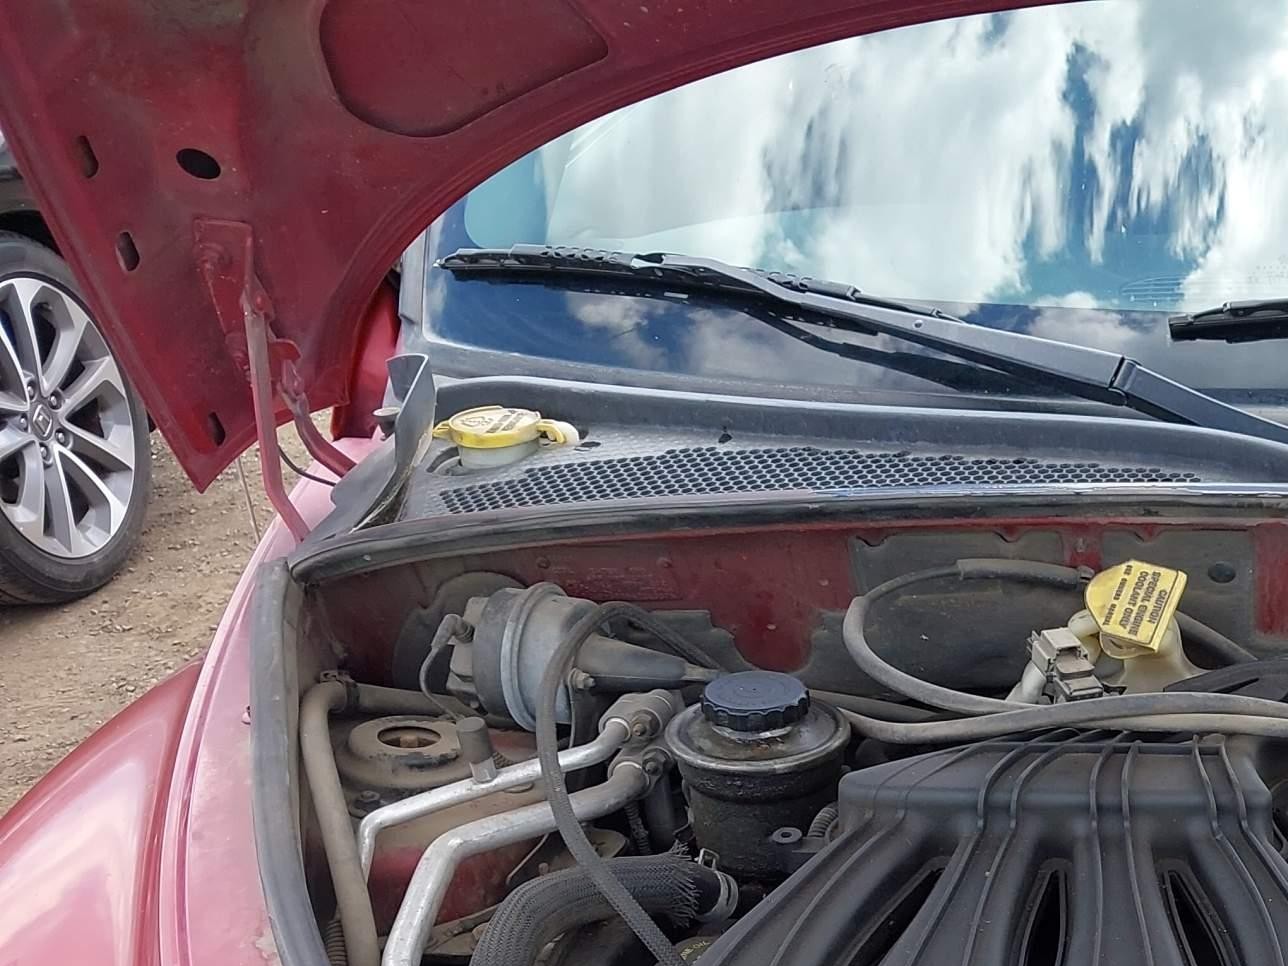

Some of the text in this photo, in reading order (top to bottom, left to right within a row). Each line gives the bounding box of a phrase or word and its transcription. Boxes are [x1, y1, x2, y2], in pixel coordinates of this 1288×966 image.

[1119, 571, 1149, 629] COOLANT ONLY
[1128, 571, 1161, 636] SPECIAL ENGINE
[1147, 590, 1167, 624] CAUTION
